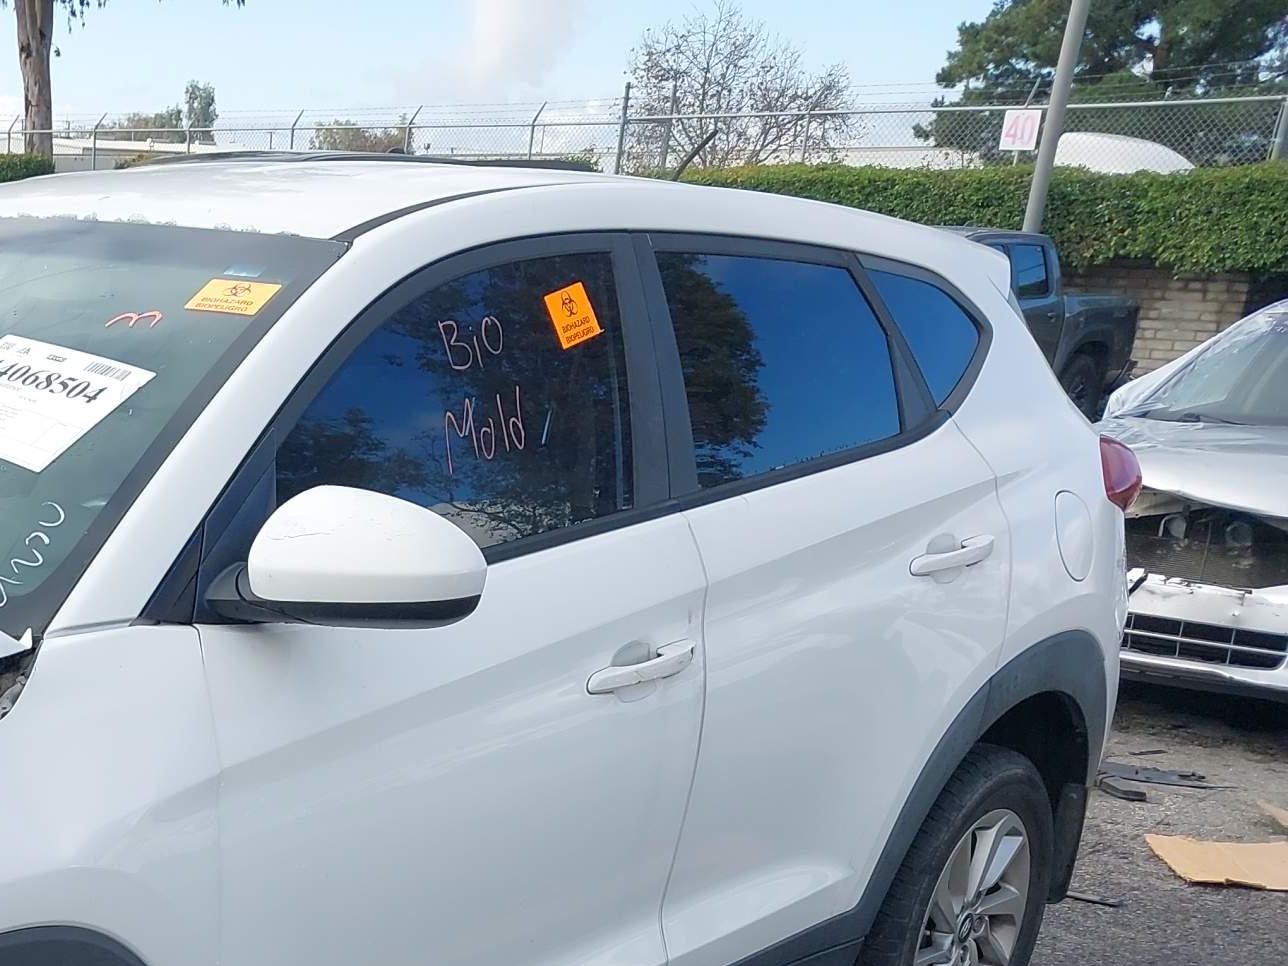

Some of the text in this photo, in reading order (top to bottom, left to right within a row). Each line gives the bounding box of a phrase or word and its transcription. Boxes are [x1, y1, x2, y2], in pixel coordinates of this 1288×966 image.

[1003, 115, 1035, 145] 40
[195, 303, 248, 312] BIOPELIGRO
[201, 297, 253, 306] BIOHAZARD
[561, 316, 590, 334] BIOHAZARD
[565, 326, 595, 344] BIOPELIGRO
